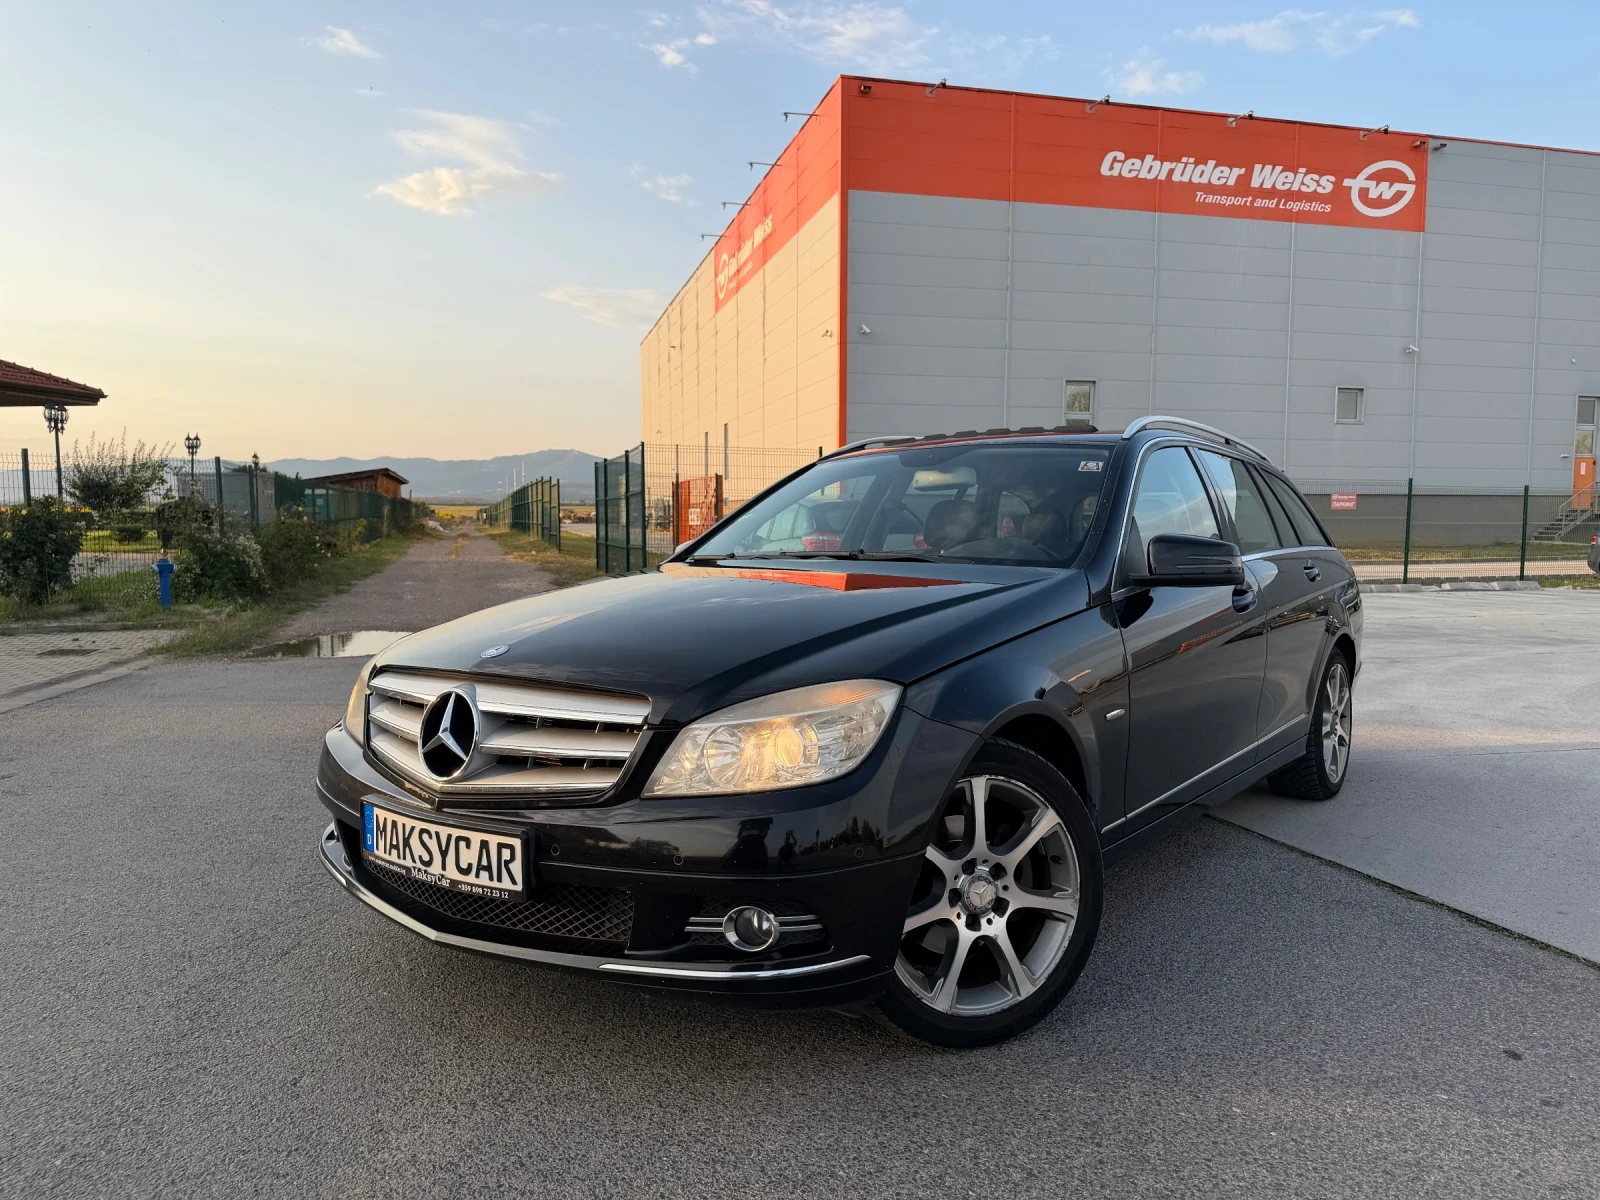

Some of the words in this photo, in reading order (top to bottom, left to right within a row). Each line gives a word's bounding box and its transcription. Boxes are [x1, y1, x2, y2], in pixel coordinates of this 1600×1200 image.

[1100, 151, 1244, 186] Gebrüder
[1250, 163, 1336, 194] Weiss
[1195, 192, 1252, 206] Transport
[1254, 197, 1278, 208] and
[1279, 199, 1332, 213] Logistics
[367, 834, 372, 845] D
[375, 813, 518, 886] MAKSYCAR
[410, 866, 451, 887] MaksyCar
[484, 888, 492, 896] 72
[501, 891, 509, 899] 12
